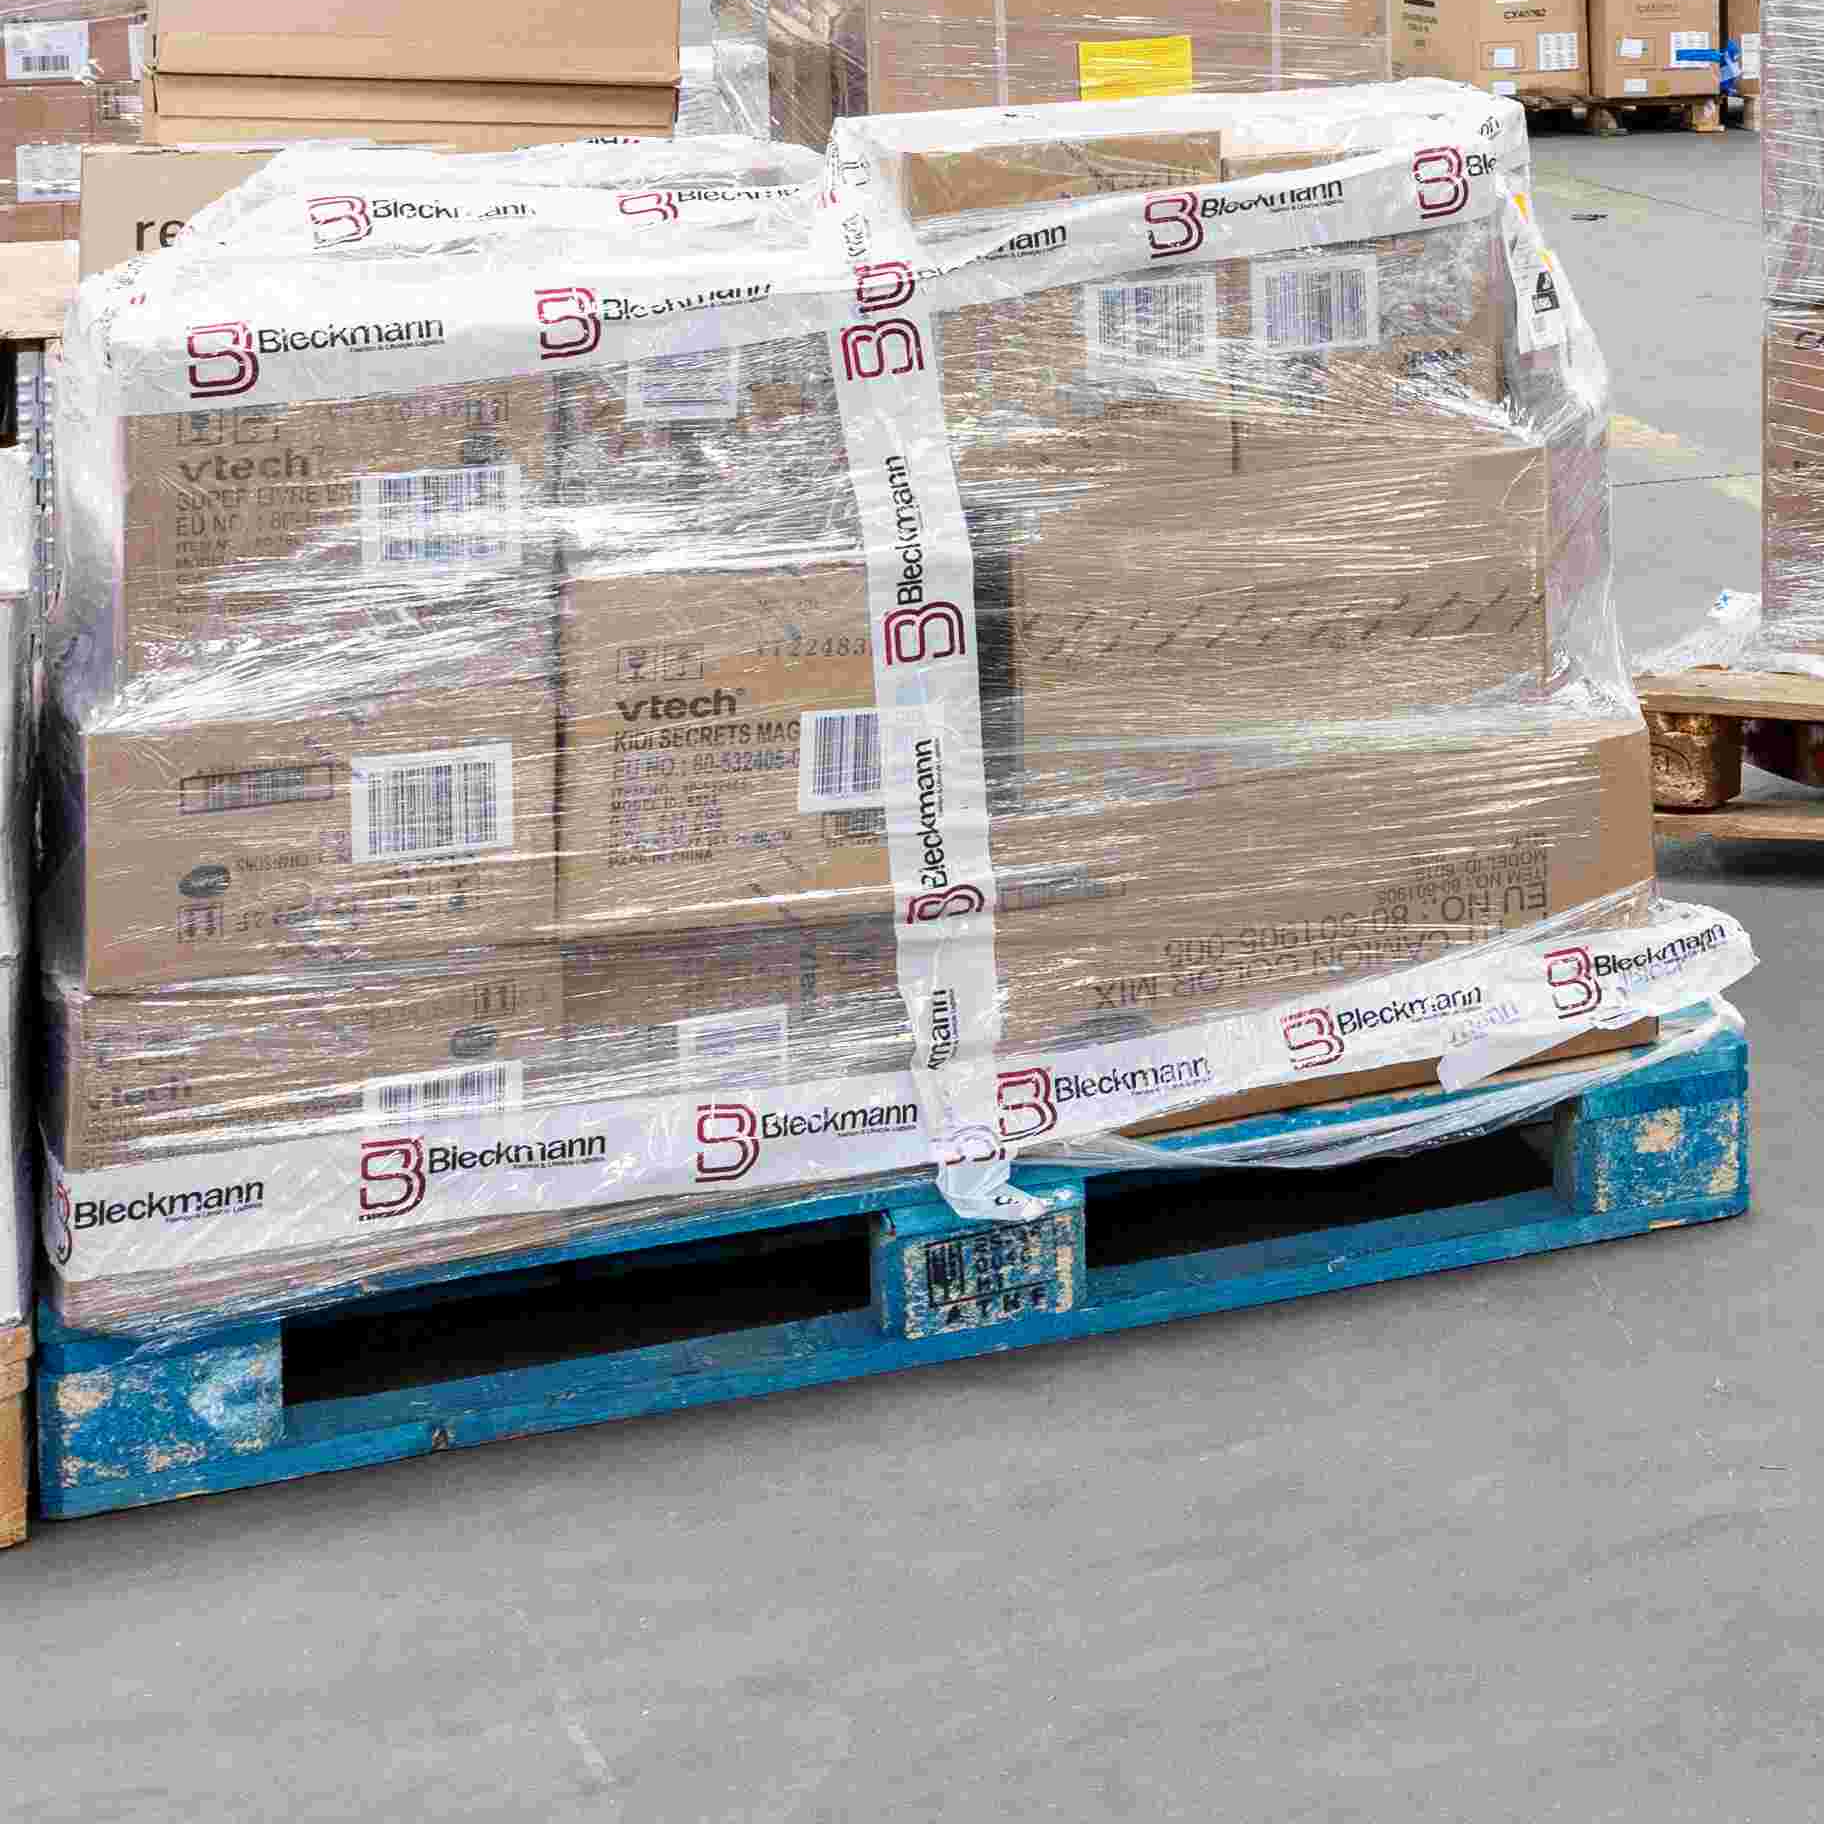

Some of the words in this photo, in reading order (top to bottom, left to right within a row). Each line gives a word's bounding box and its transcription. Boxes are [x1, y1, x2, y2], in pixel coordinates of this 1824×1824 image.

[257, 319, 445, 354] Bleckmann
[178, 447, 311, 482] vtech
[615, 687, 738, 722] vtech
[656, 722, 751, 749] SECRETS
[1504, 881, 1547, 912] EU
[1054, 1052, 1213, 1104] Bleckmann
[761, 1100, 919, 1139] Bleckmann
[427, 1132, 608, 1175] Bleckmann
[73, 1178, 265, 1231] Bleckmann
